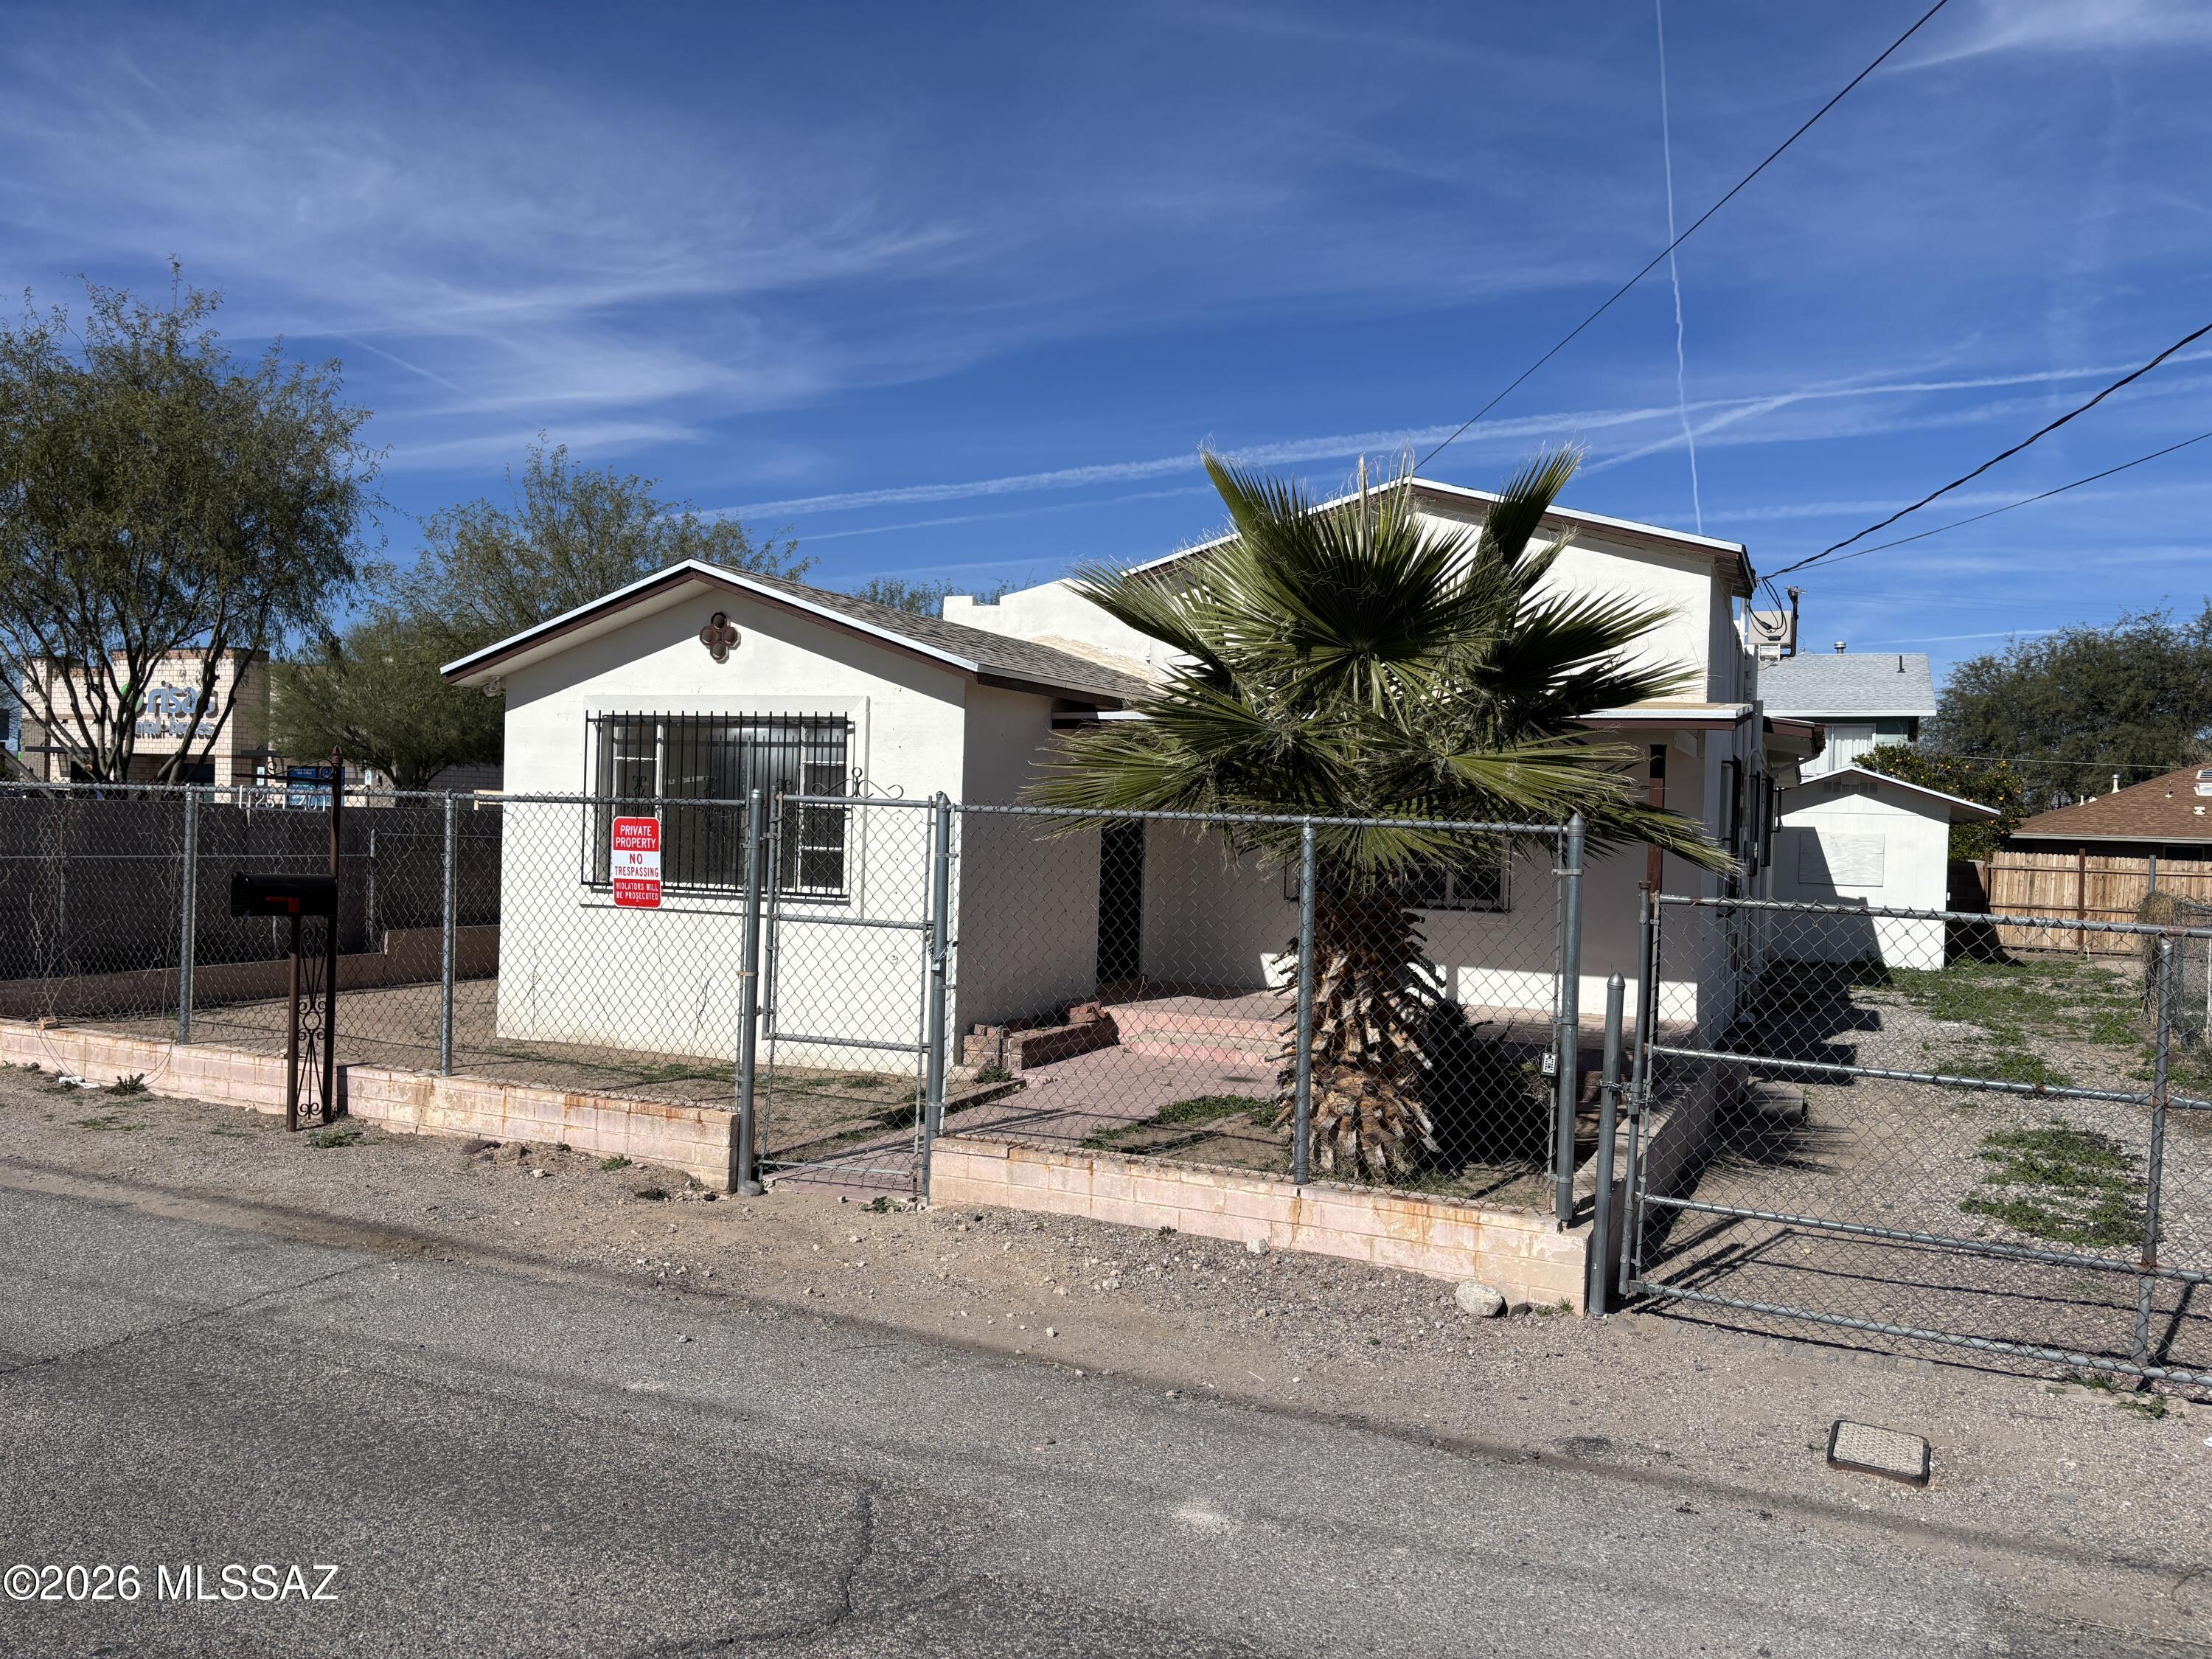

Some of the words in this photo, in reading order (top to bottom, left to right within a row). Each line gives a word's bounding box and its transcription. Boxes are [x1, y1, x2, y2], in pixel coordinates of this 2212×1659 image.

[620, 824, 653, 836] PRIVATE
[616, 838, 656, 849] PROPERTY
[629, 853, 643, 864] NO
[615, 866, 659, 877] TRESPASSING
[616, 882, 644, 891] VIOLATORS
[646, 883, 658, 891] WILL
[616, 891, 623, 899] BE
[625, 891, 658, 901] PROSECUTED
